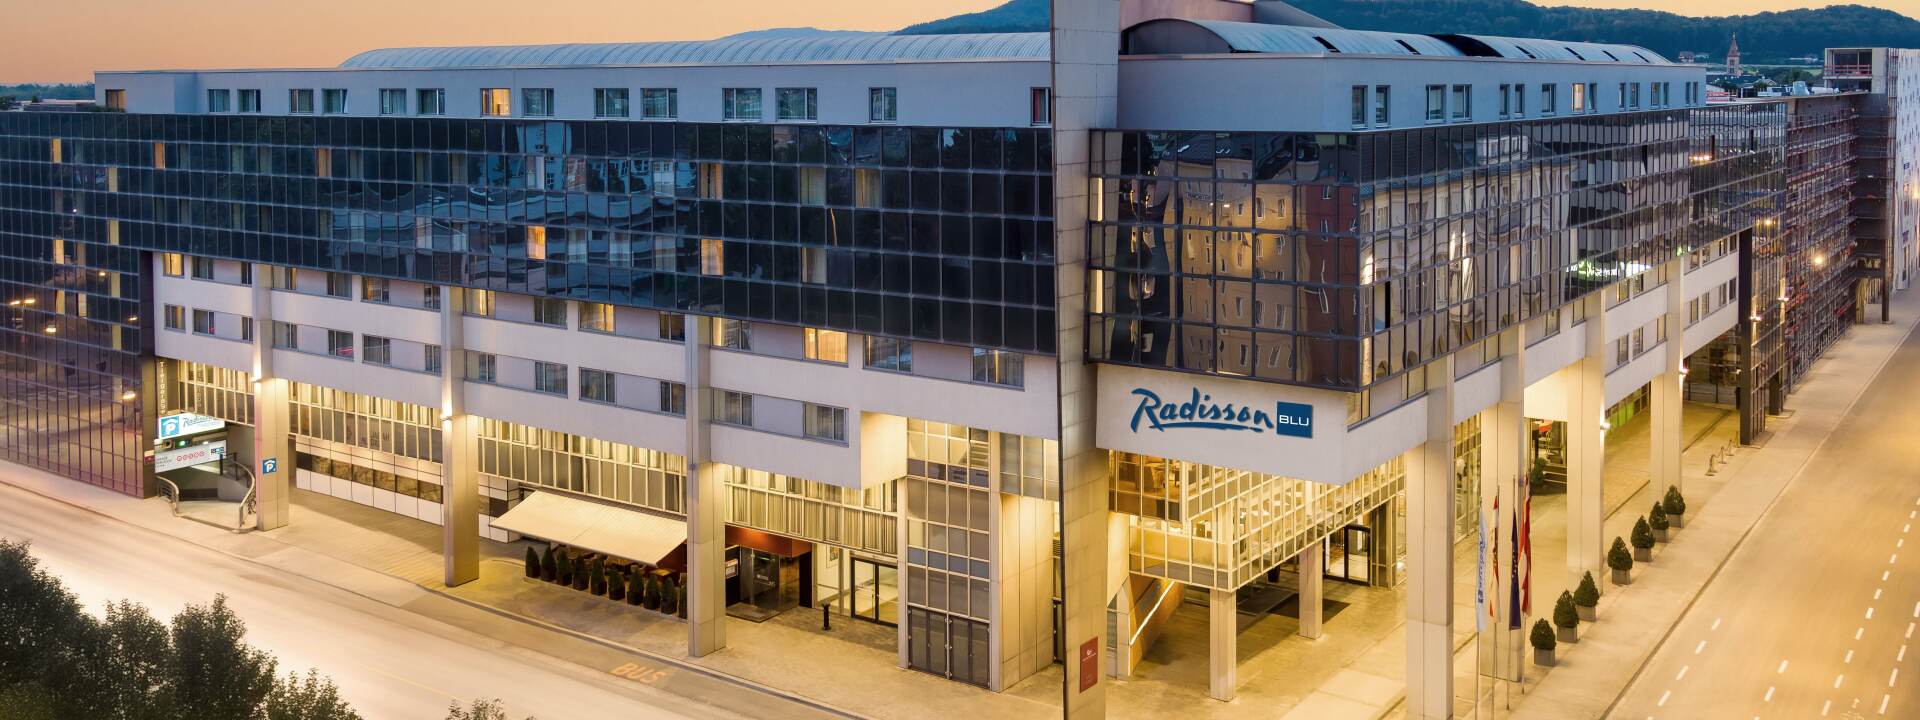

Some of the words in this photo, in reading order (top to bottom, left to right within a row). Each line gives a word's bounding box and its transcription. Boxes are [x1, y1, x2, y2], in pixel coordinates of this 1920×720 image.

[1130, 387, 1274, 433] Radisson
[1279, 414, 1309, 427] BLU
[610, 662, 667, 684] BUS
